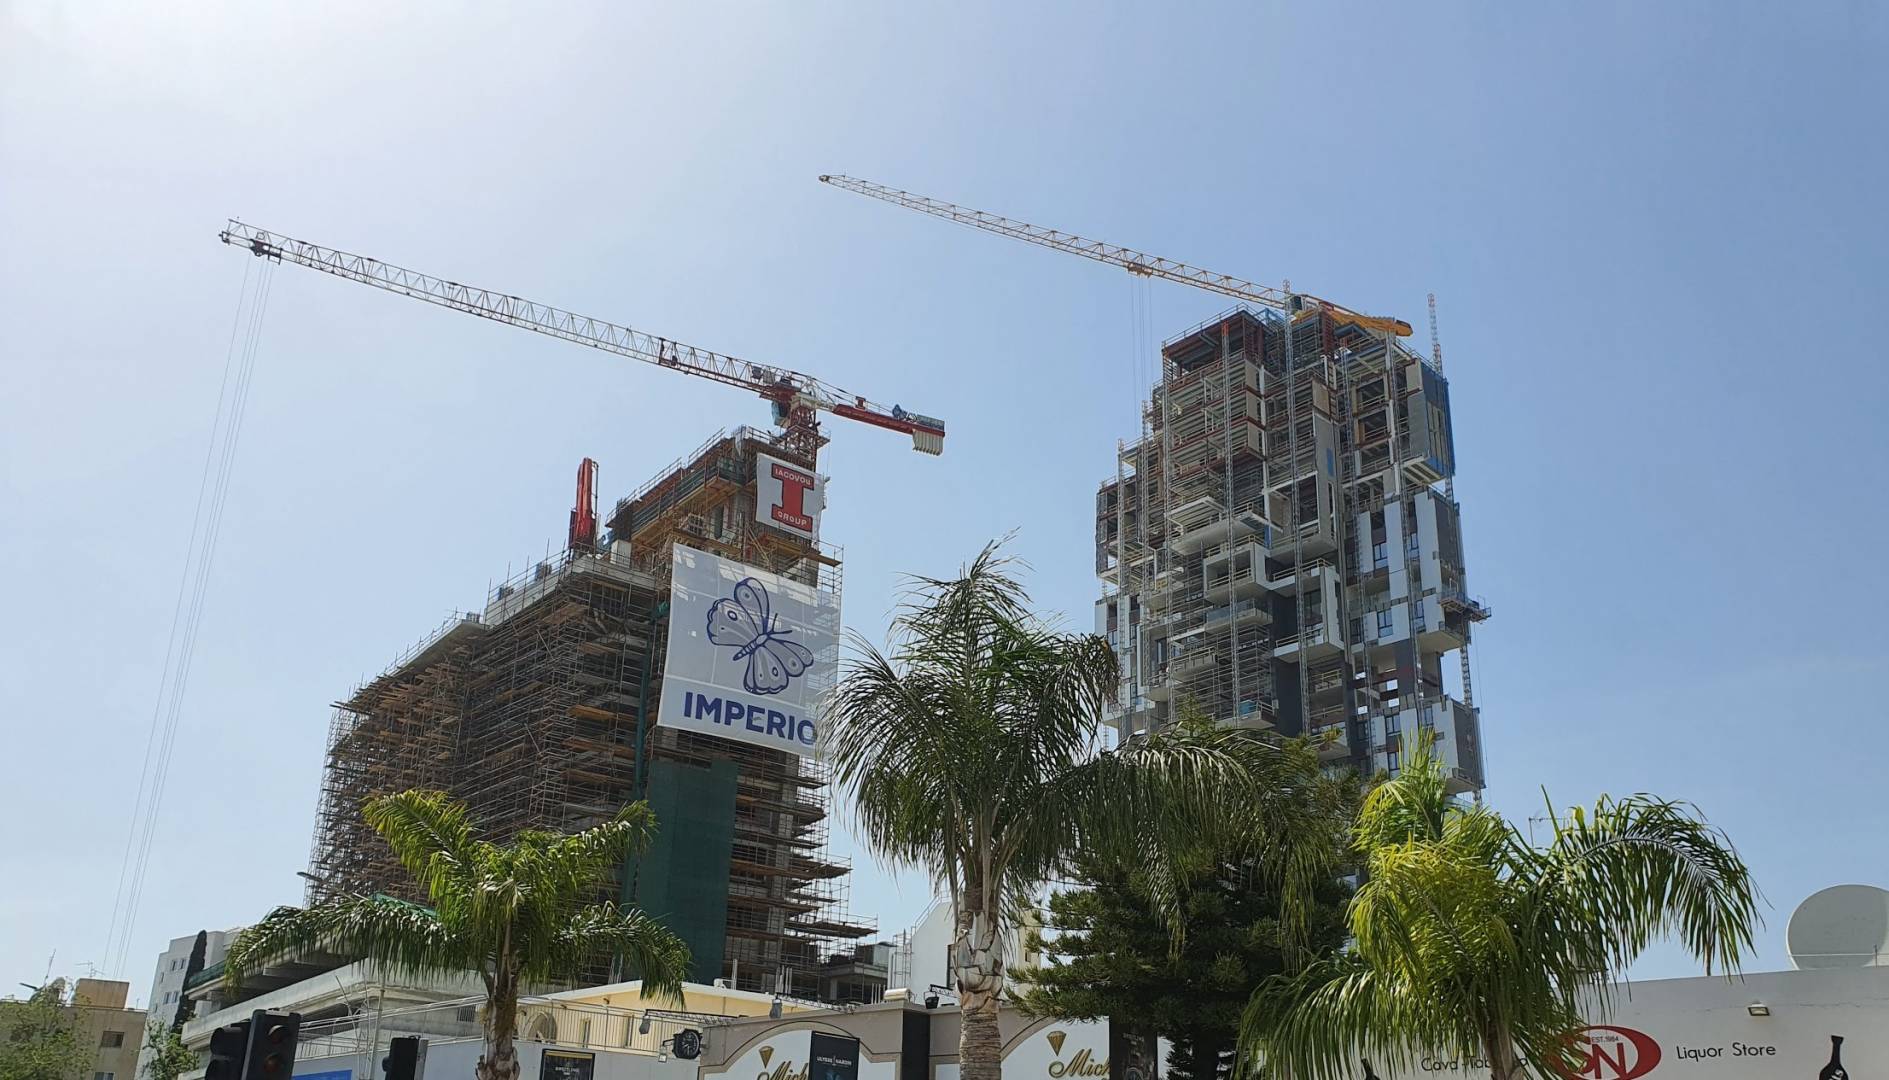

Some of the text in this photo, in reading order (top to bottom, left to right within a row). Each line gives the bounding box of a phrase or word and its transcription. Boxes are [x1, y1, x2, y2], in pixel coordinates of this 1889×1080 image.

[775, 468, 811, 485] IACOVOU
[777, 510, 807, 526] GROUP
[1676, 1042, 1776, 1062] Liquor Store
